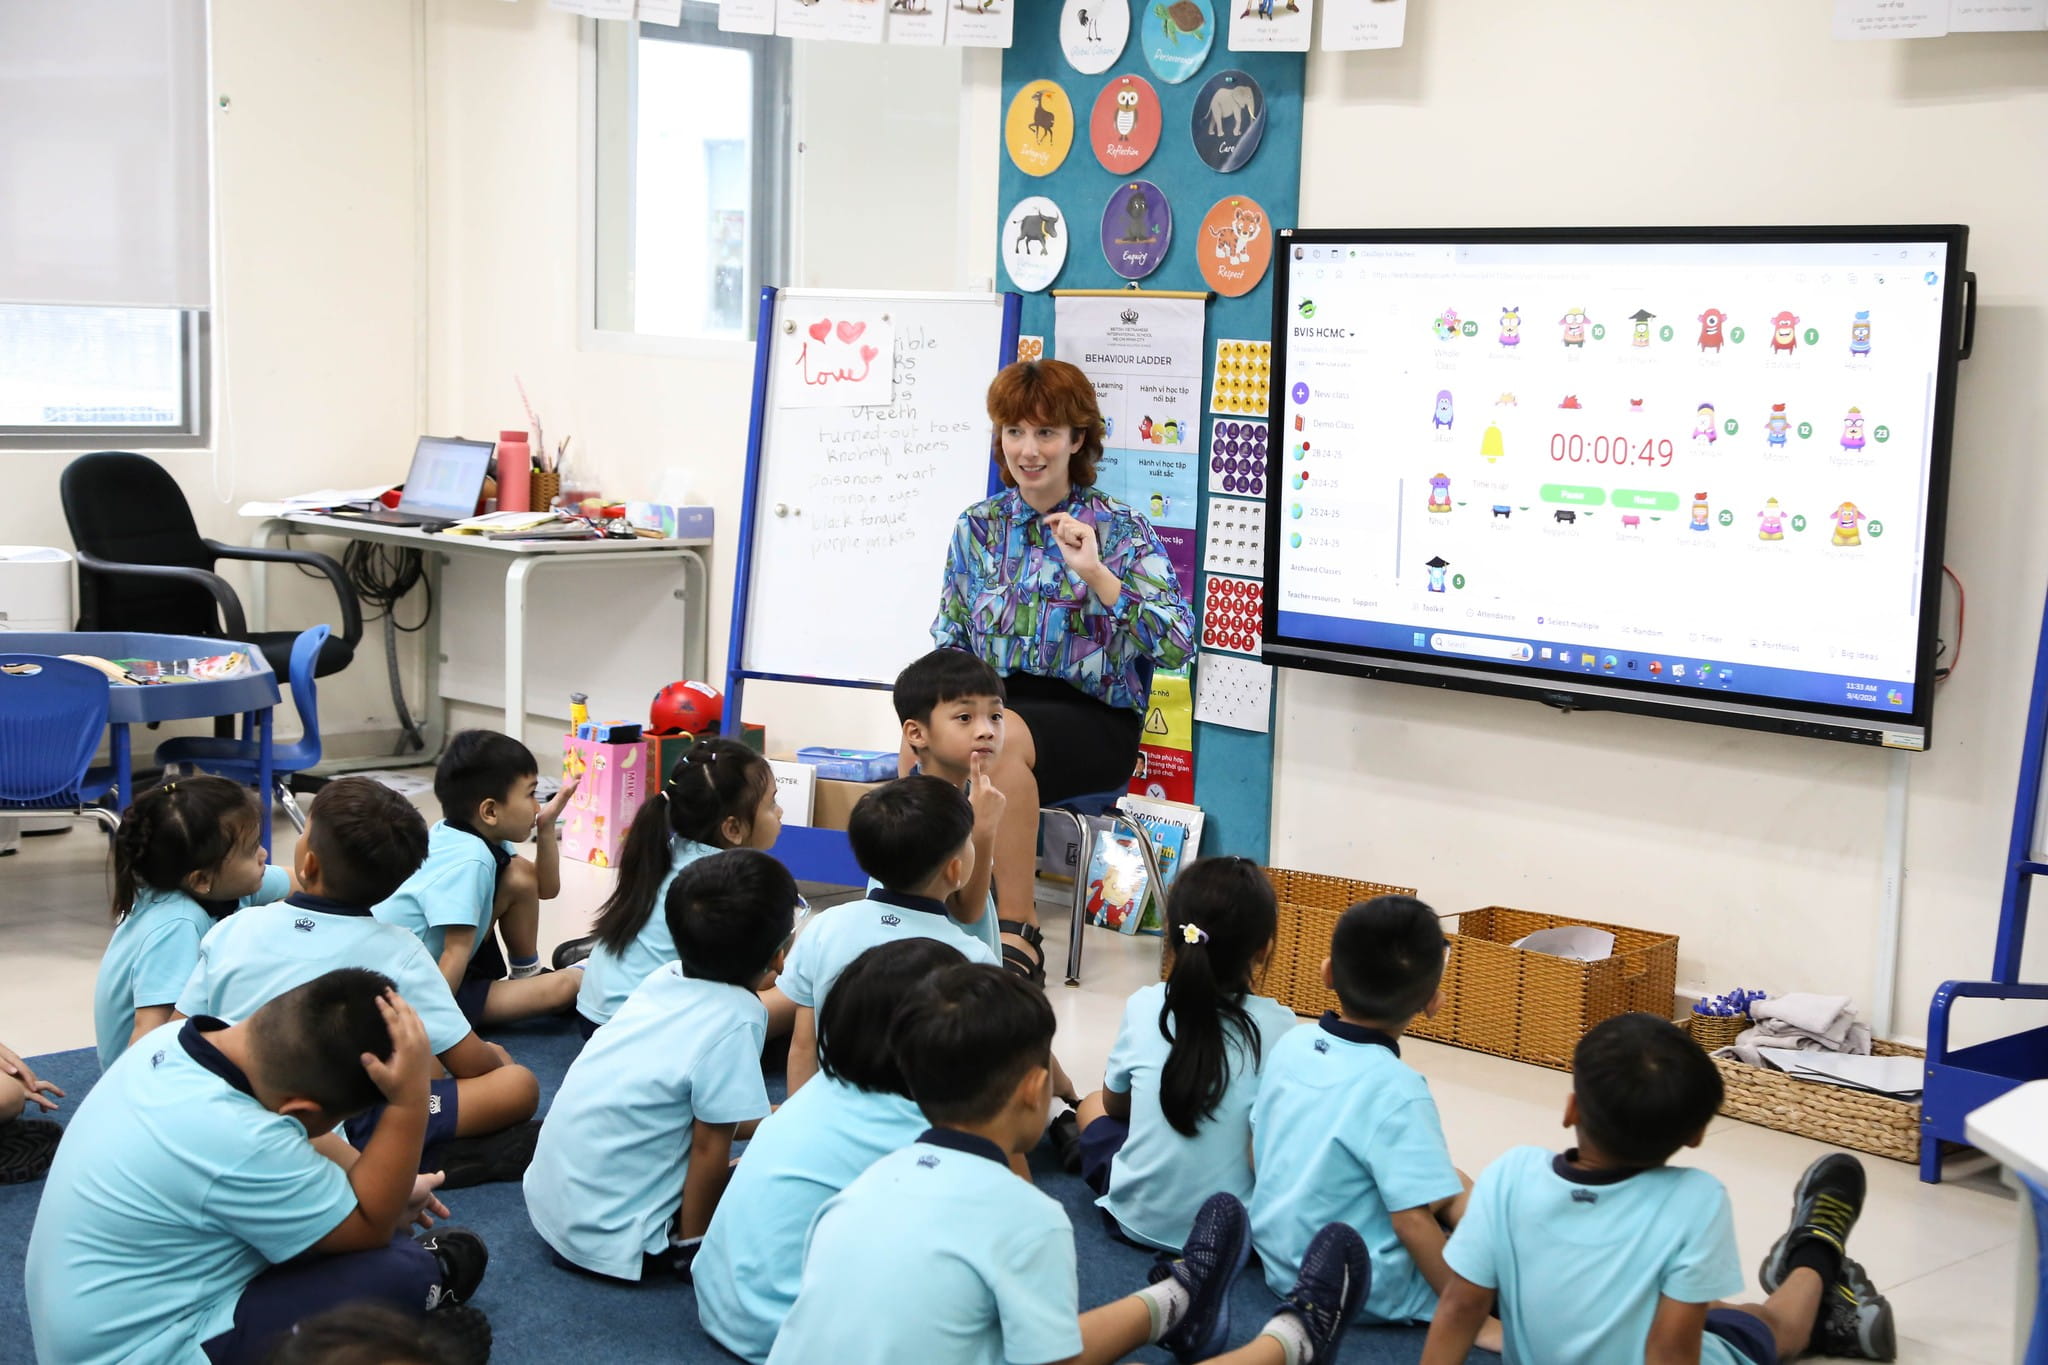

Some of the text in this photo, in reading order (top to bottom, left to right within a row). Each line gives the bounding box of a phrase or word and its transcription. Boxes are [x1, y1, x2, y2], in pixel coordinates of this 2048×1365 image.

[1106, 143, 1139, 157] Reflection
[1218, 142, 1235, 153] Care
[1122, 250, 1148, 265] Enquiry
[1217, 265, 1245, 280] Respect
[1293, 326, 1345, 338] BVIS HCMC
[1594, 328, 1603, 336] 10
[1663, 329, 1670, 338] 5
[1734, 331, 1740, 339] 7
[1085, 353, 1172, 365] BEHAVIOUR LADDER
[1097, 382, 1123, 391] Learning
[1314, 390, 1350, 400] New class
[930, 420, 971, 434] toes
[1313, 419, 1355, 430] Demo Class
[1726, 422, 1736, 431] 17
[1800, 426, 1809, 434] 12
[1876, 429, 1887, 438] 23
[1322, 449, 1342, 459] 24-25
[1551, 433, 1673, 467] 00:00:49
[896, 466, 937, 481] wart
[1318, 479, 1339, 488] 24-25
[1320, 508, 1341, 518] 24-25
[1720, 513, 1732, 522] 25
[1870, 524, 1881, 533] 23
[1308, 537, 1341, 547] 2V 24-25
[1290, 563, 1342, 576] Archived Classes
[1456, 577, 1462, 586] 5
[1287, 590, 1341, 604] Teacher resources
[1352, 598, 1378, 608] Support
[1422, 604, 1444, 613] Toolkit
[1477, 611, 1516, 622] Attendance
[1548, 617, 1600, 631] Select multiple
[1633, 626, 1663, 637] Random
[1702, 634, 1723, 644] Timer
[1762, 640, 1800, 652] Portfolios
[1846, 682, 1878, 692] 11:33 AM
[1846, 692, 1877, 703] 9/4/2024
[1177, 764, 1190, 773] gian
[627, 771, 636, 798] MILK
